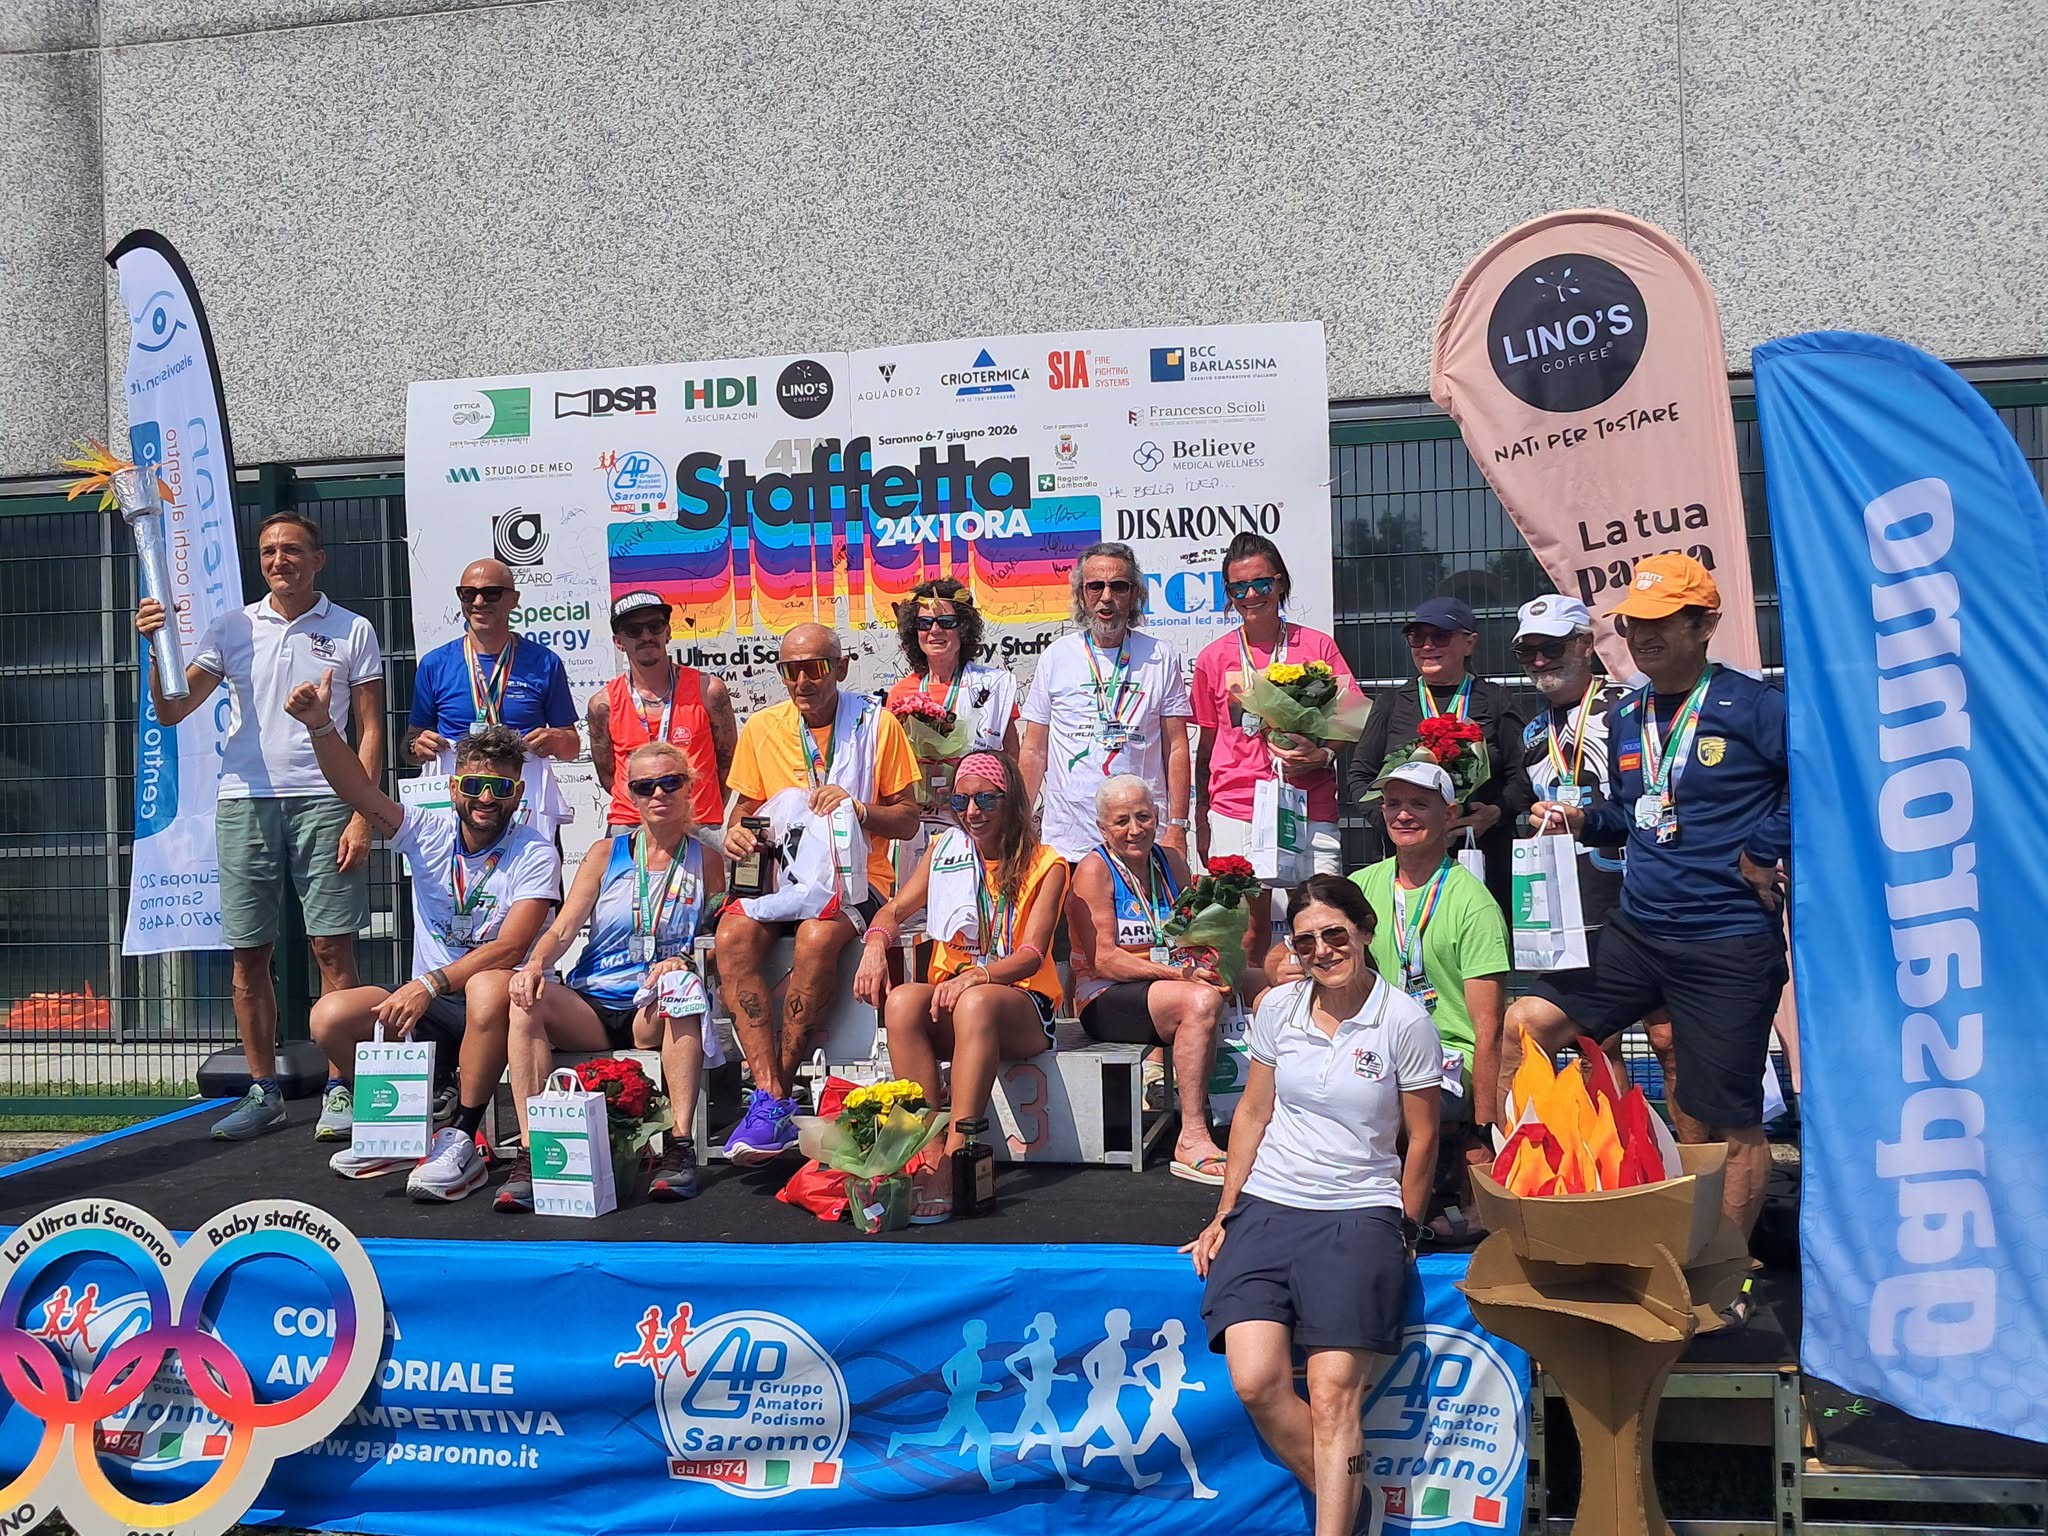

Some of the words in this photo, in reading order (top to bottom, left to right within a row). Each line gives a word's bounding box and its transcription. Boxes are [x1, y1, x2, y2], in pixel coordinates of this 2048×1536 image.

[1502, 303, 1633, 365] LINO'S
[1094, 356, 1111, 365] FIRE
[1189, 346, 1216, 357] BCC
[1541, 347, 1609, 374] COFFEE
[1048, 350, 1089, 390] SIA
[1095, 366, 1129, 376] FIGHTING
[1190, 358, 1277, 373] BARLASSINA
[940, 368, 1030, 386] CRIOTERMICA
[1095, 378, 1130, 388] SYSTEMS
[685, 376, 757, 410] HDI
[782, 383, 828, 397] LINO'S
[857, 387, 921, 401] AQUADRO2
[593, 386, 656, 413] DSR
[685, 412, 758, 424] ASSICURAZIONI
[1149, 405, 1222, 418] Francesco
[1227, 400, 1266, 413] Scioli
[878, 432, 923, 446] Saronno
[925, 430, 944, 442] 6-7
[945, 428, 985, 444] giugno
[988, 424, 1018, 436] 2026
[1547, 427, 1588, 450] PER
[1173, 438, 1256, 458] Believe
[485, 465, 526, 476] STUDIO
[531, 463, 544, 474] DE
[548, 461, 573, 472] MEO
[1173, 459, 1214, 470] MEDICAL
[1216, 458, 1265, 469] WELLNESS
[676, 436, 1031, 531] Staffetta
[614, 492, 664, 501] Saronno
[1116, 503, 1281, 541] DISARONNO
[1578, 519, 1628, 552] La
[1633, 503, 1709, 538] tua
[509, 600, 590, 628] Special
[1195, 615, 1214, 625] led
[568, 658, 594, 666] futuro
[676, 646, 726, 667] Ultra
[730, 644, 749, 665] di
[402, 780, 449, 794] OTTICA
[357, 1049, 427, 1060] OTTICA
[528, 1105, 586, 1119] OTTICA
[1004, 1063, 1049, 1152] 3
[353, 1139, 424, 1152] OTTICA
[535, 1197, 594, 1211] OTTICA
[3, 1238, 30, 1264] La
[27, 1213, 77, 1242] Ultra
[80, 1205, 100, 1224] di
[102, 1206, 172, 1267] Saronno
[207, 1213, 261, 1247] Baby
[264, 1210, 341, 1253] staffetta
[266, 1354, 515, 1395] AMORIALE
[759, 1382, 823, 1397] Gruppo
[754, 1397, 823, 1411] Amatori
[1437, 1398, 1500, 1418] Gruppo
[751, 1412, 826, 1426] Podismo
[1429, 1415, 1499, 1435] Amatori
[683, 1427, 832, 1452] Saronno
[1424, 1431, 1497, 1453] Podismo
[676, 1463, 700, 1475] dal
[704, 1461, 745, 1478] 1974
